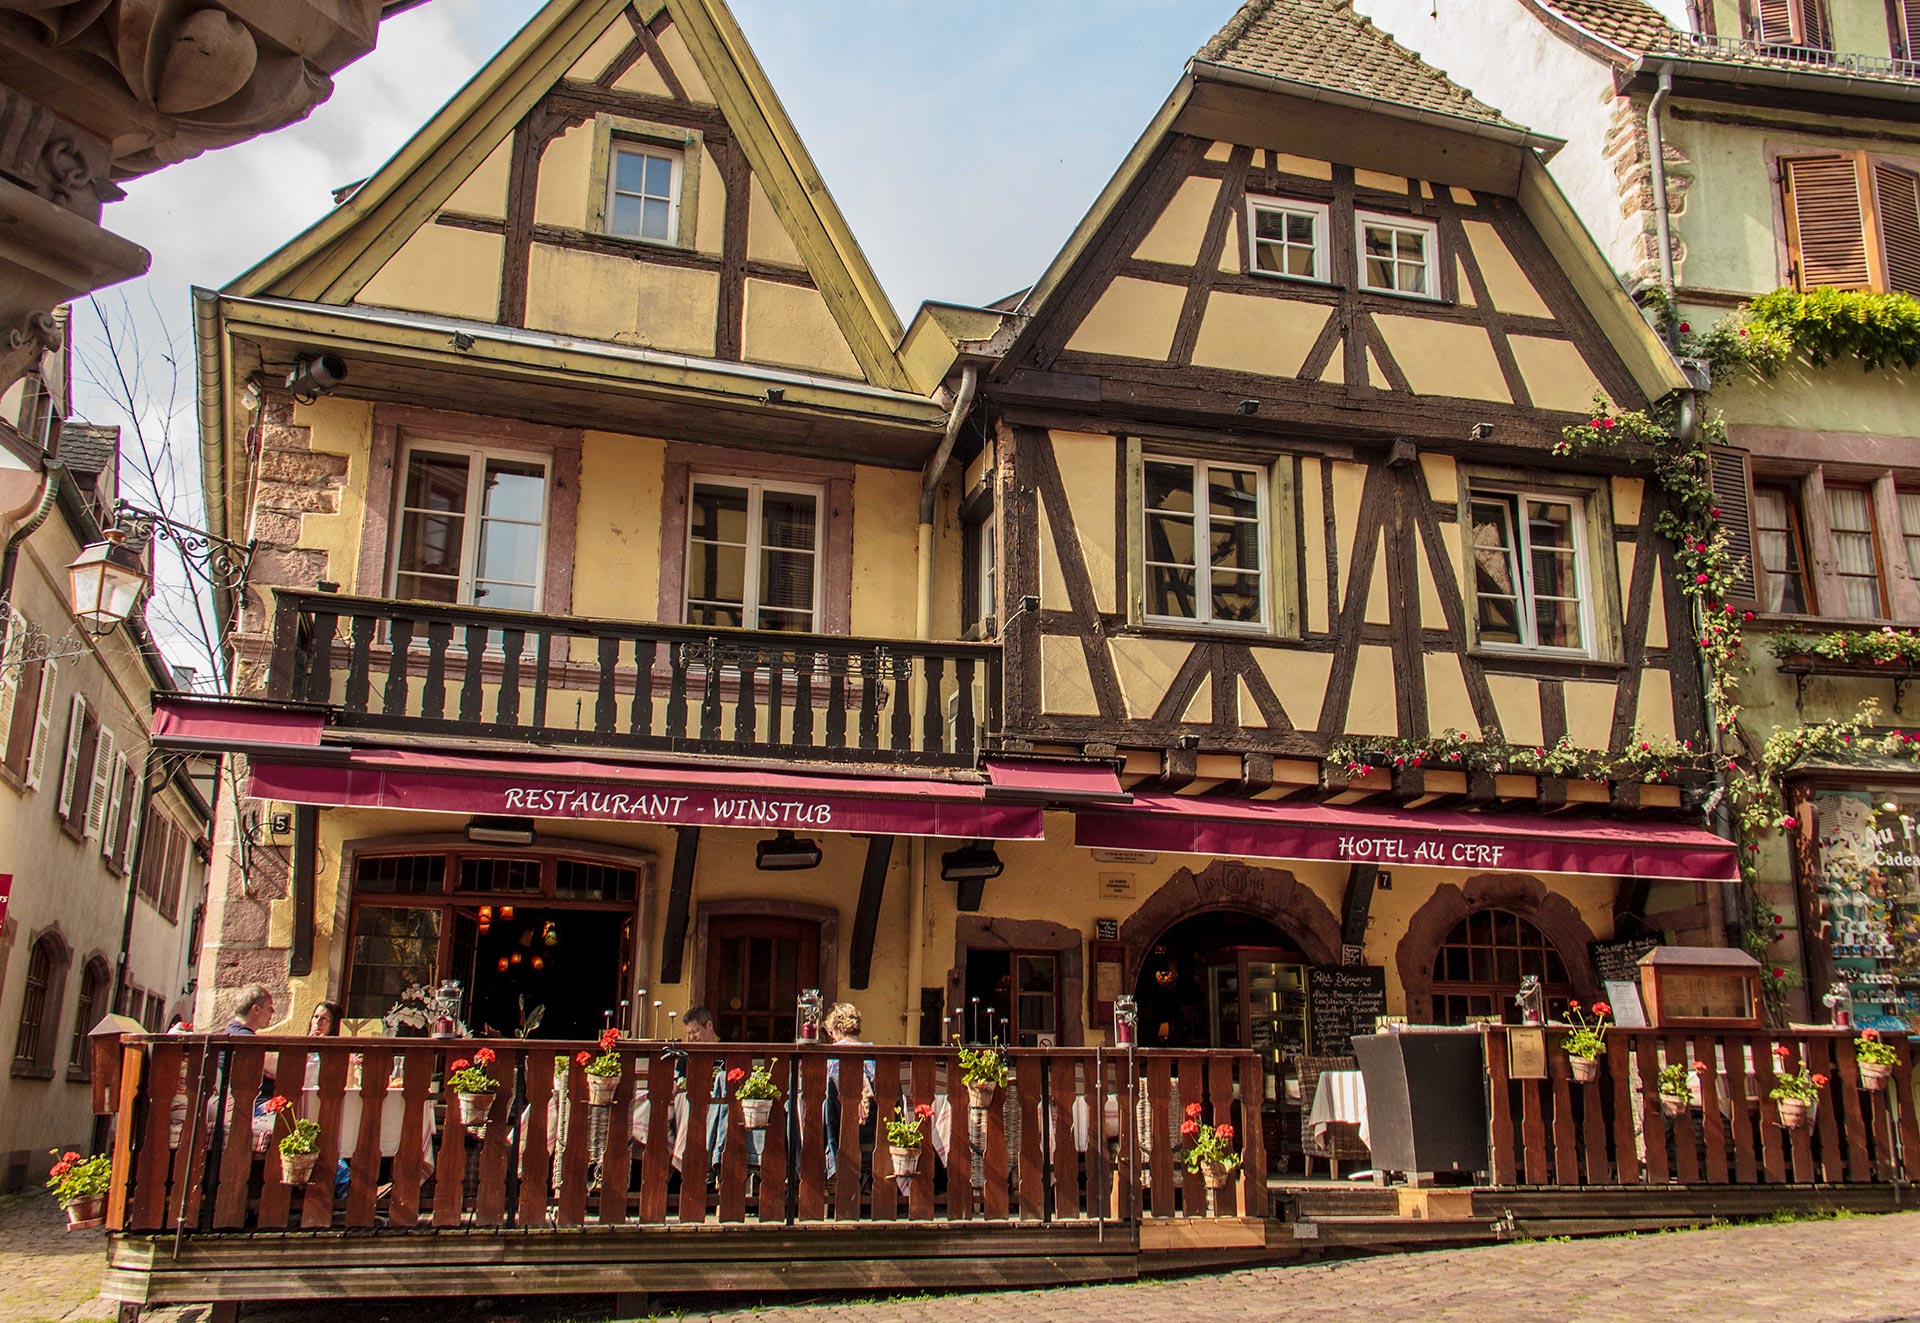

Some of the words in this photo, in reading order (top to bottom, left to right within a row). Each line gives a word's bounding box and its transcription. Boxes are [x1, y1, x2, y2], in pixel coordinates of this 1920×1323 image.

[504, 788, 688, 816] RESTAURANT
[712, 797, 832, 824] WINSTUB
[276, 816, 286, 831] 5
[1338, 836, 1409, 859] HOTEL
[1414, 841, 1446, 860] AU
[1451, 843, 1505, 865] CERF
[1862, 826, 1895, 851] Au
[1381, 874, 1389, 887] 7
